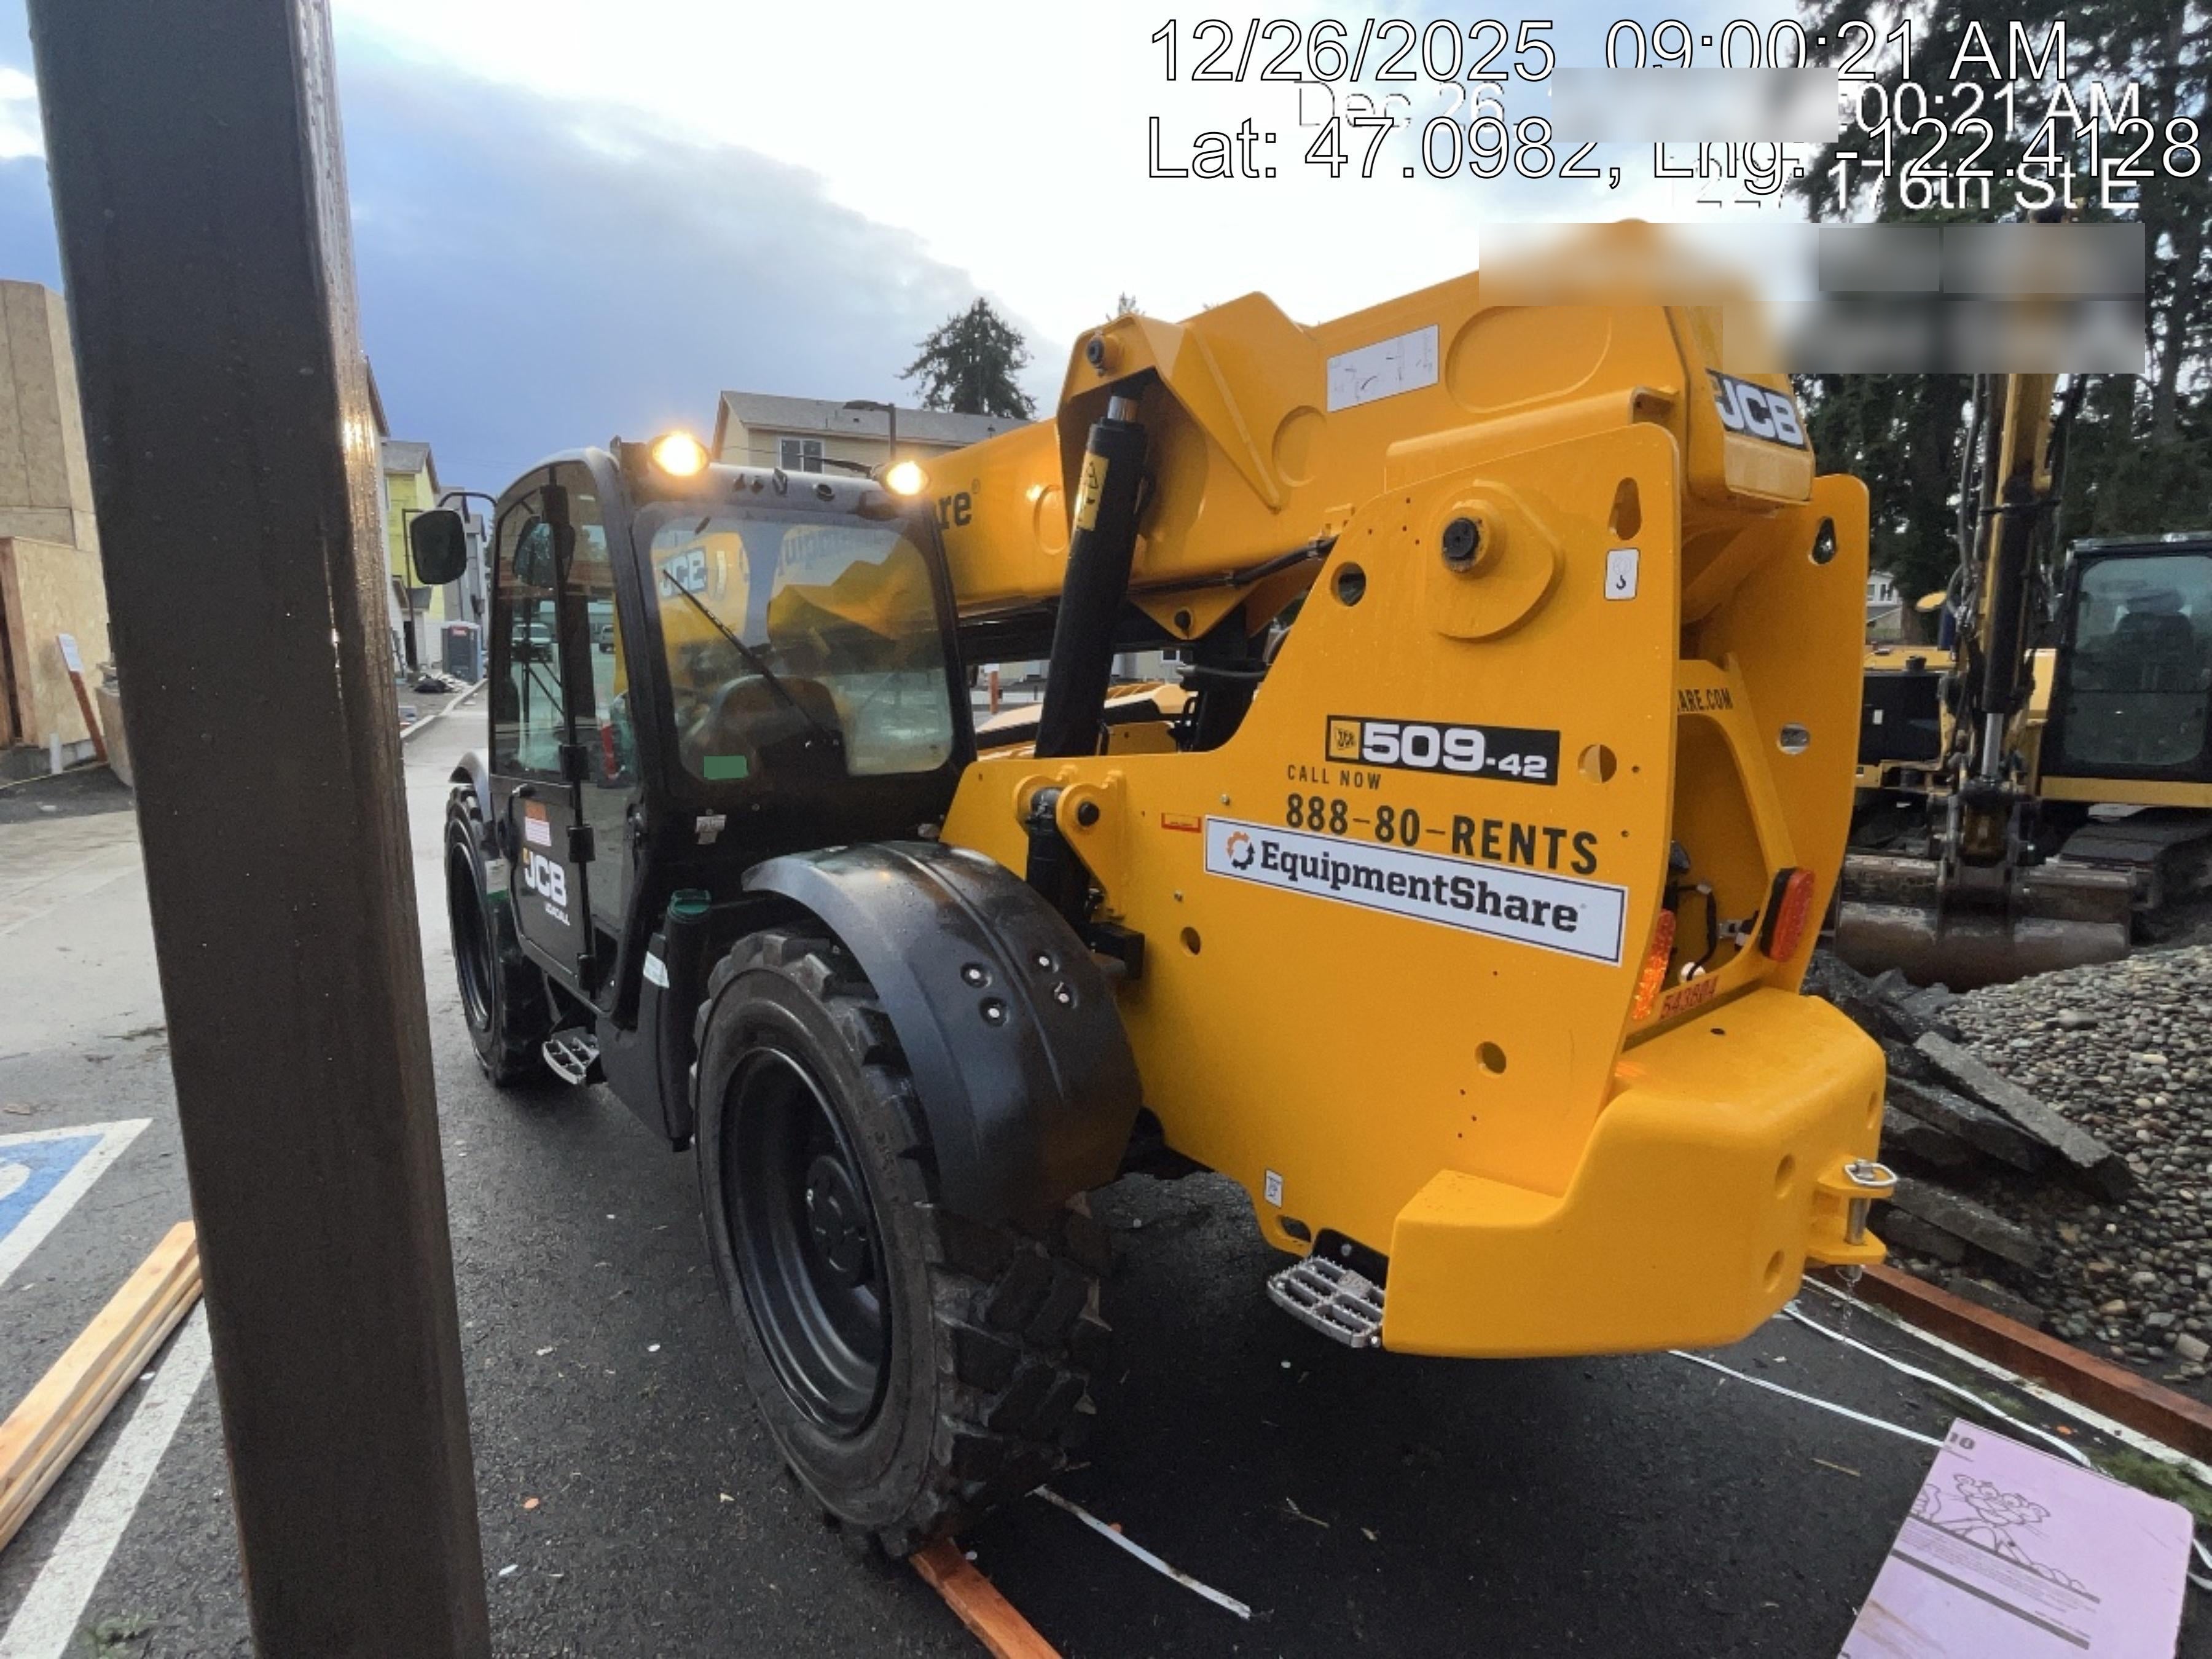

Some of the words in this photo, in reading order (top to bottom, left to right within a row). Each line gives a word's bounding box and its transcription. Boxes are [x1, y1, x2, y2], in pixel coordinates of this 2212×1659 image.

[1715, 377, 1805, 446] JCB
[1287, 764, 1330, 785] CALL
[1339, 769, 1382, 791] NOW
[1362, 721, 1548, 779] 509-42
[1285, 793, 1598, 875] 888-80-RENTS
[524, 849, 567, 908] JCB
[1260, 839, 1579, 933] EquipmentShare
